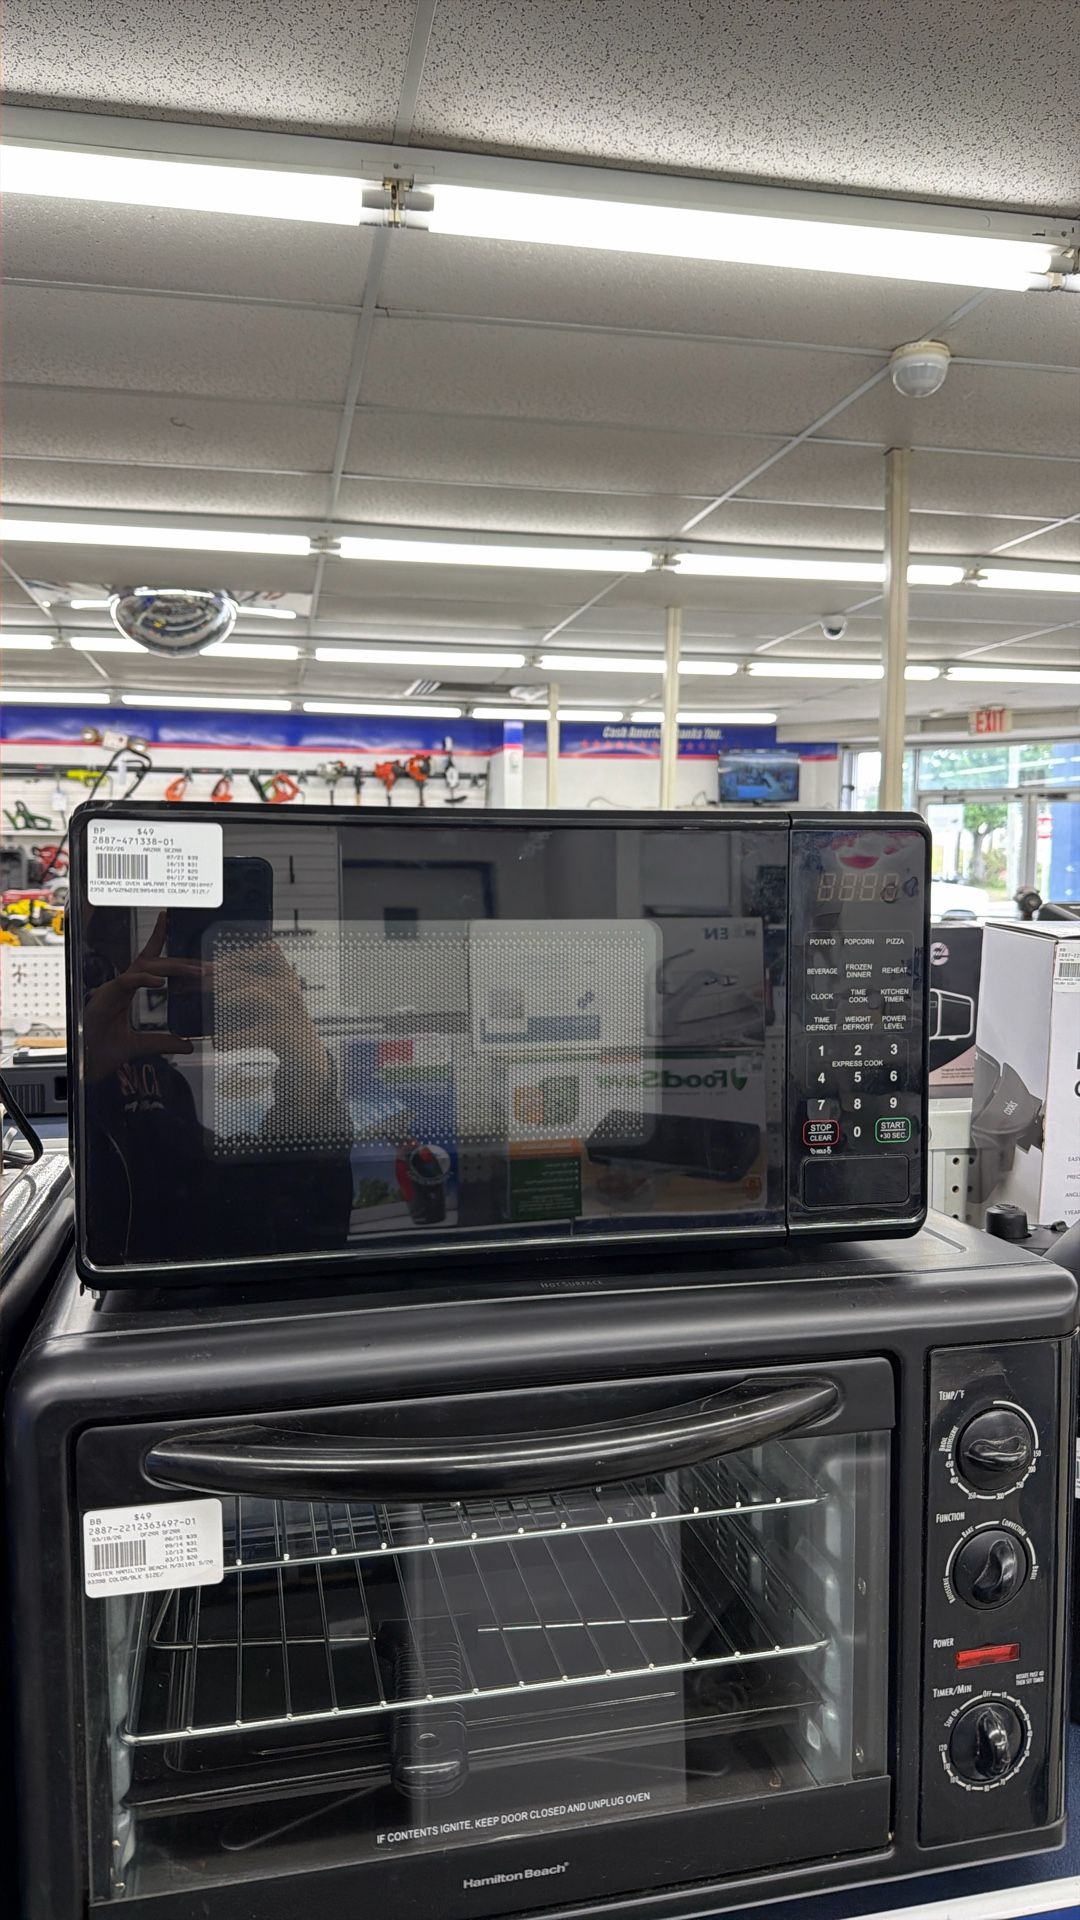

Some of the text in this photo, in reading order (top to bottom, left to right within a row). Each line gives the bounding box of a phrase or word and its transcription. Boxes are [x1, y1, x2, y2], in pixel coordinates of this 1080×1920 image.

[976, 710, 1005, 732] EXIT
[602, 726, 627, 738] Cash
[628, 726, 661, 739] Americ
[137, 828, 154, 836] $49
[92, 836, 174, 846] 2887-471338-01
[845, 963, 873, 971] FROZEN
[881, 966, 908, 974] REHEAT
[842, 1023, 874, 1031] DEFROST
[818, 1045, 824, 1056] 1
[854, 1045, 862, 1056] 2
[890, 1043, 898, 1055] 3
[832, 1060, 862, 1068] EXPRESS
[817, 1072, 825, 1083] 4
[854, 1071, 862, 1082] 5
[889, 1070, 898, 1081] 6
[817, 1100, 825, 1111] 7
[853, 1098, 862, 1110] 8
[889, 1097, 898, 1108] 9
[810, 1124, 832, 1132] STOP
[880, 1121, 906, 1129] START
[853, 1126, 861, 1137] 0
[133, 1512, 152, 1521] $49
[88, 1517, 196, 1536] 2887-2212363497-01
[115, 1567, 146, 1575] HAMILTON
[933, 1638, 954, 1648] POWER
[377, 1834, 386, 1844] IF
[387, 1826, 439, 1843] CONTENTS
[475, 1816, 500, 1829] KEEP
[501, 1811, 528, 1824] DOOR
[529, 1805, 566, 1820] CLOSED
[567, 1802, 587, 1813] AND
[587, 1796, 624, 1810] UNPLUG
[625, 1792, 650, 1804] OVEN
[463, 1872, 523, 1889] Hamilton
